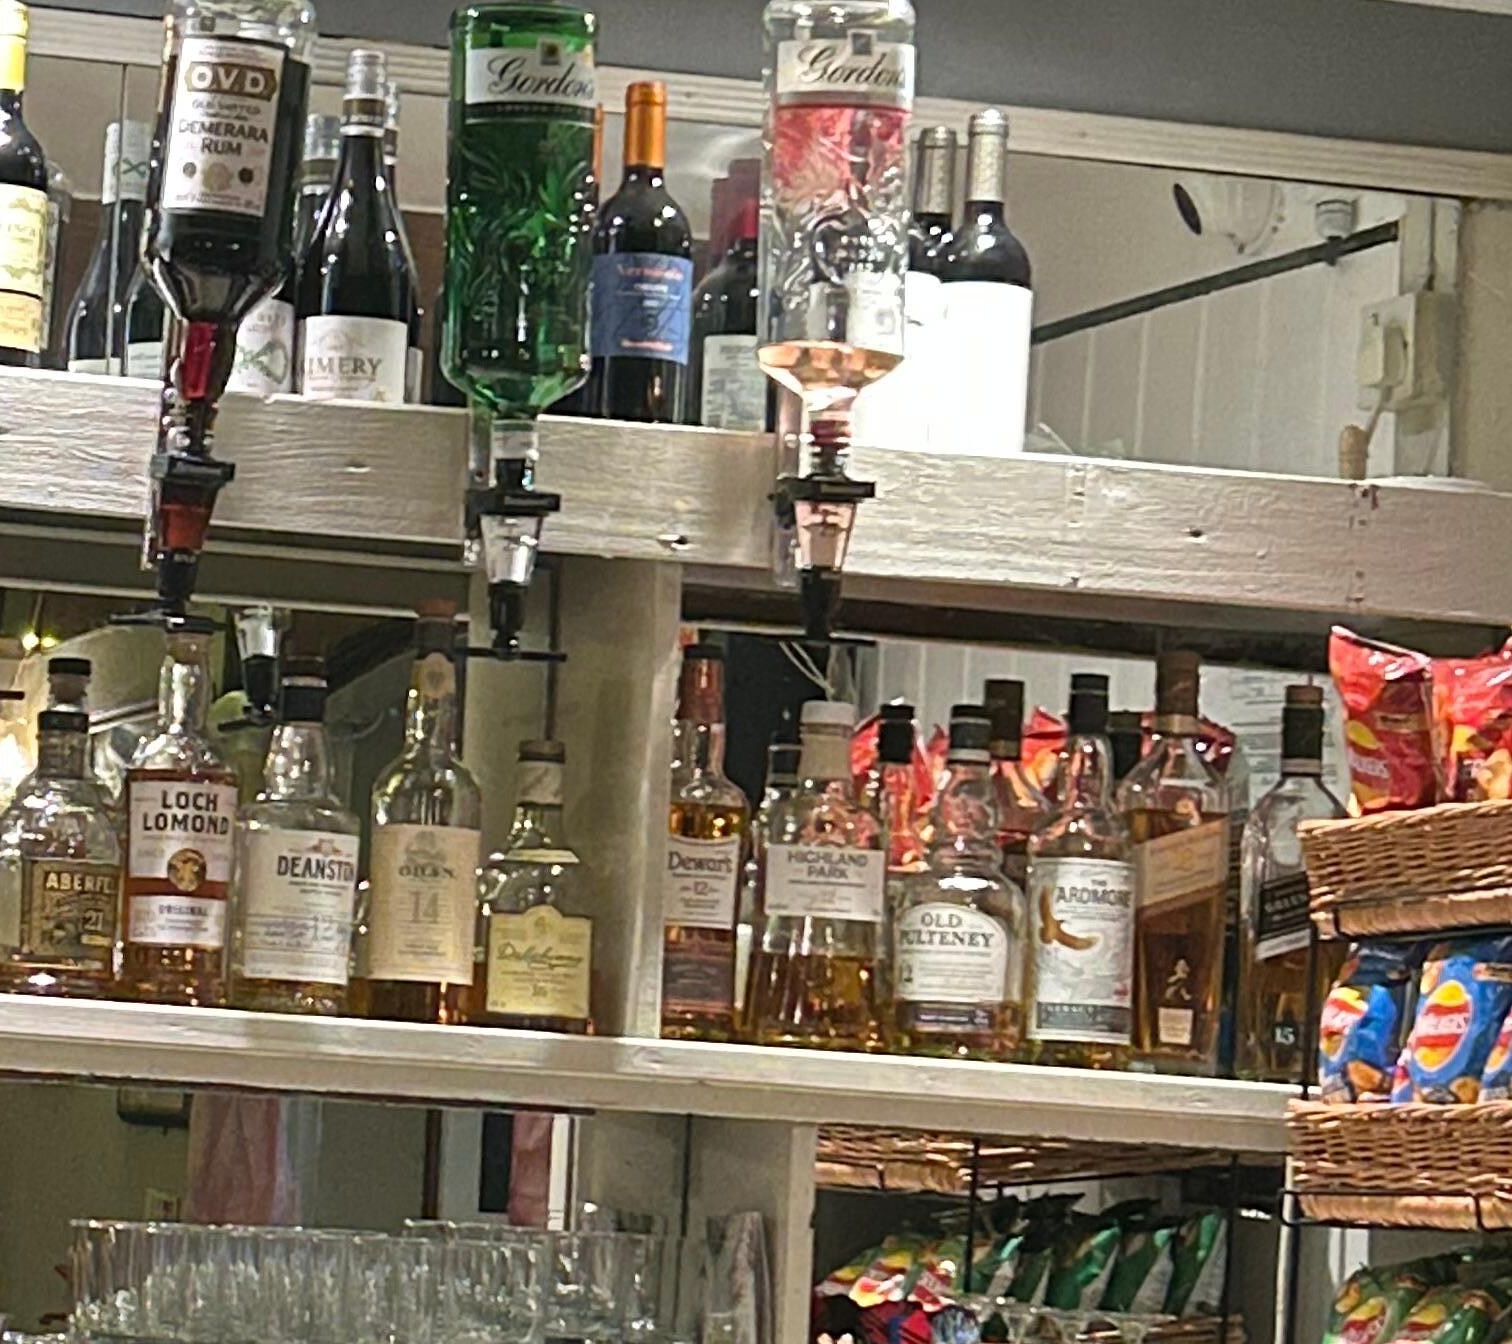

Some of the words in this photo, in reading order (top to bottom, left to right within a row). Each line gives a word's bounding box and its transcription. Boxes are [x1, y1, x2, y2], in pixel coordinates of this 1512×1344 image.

[178, 118, 269, 144] DEMERARA
[201, 137, 243, 156] RUM
[161, 789, 219, 813] LOCH
[143, 812, 230, 836] LOMOND
[787, 849, 868, 868] HIGHLAND
[807, 865, 849, 879] PARK
[408, 890, 440, 924] 14
[920, 912, 963, 929] OLD
